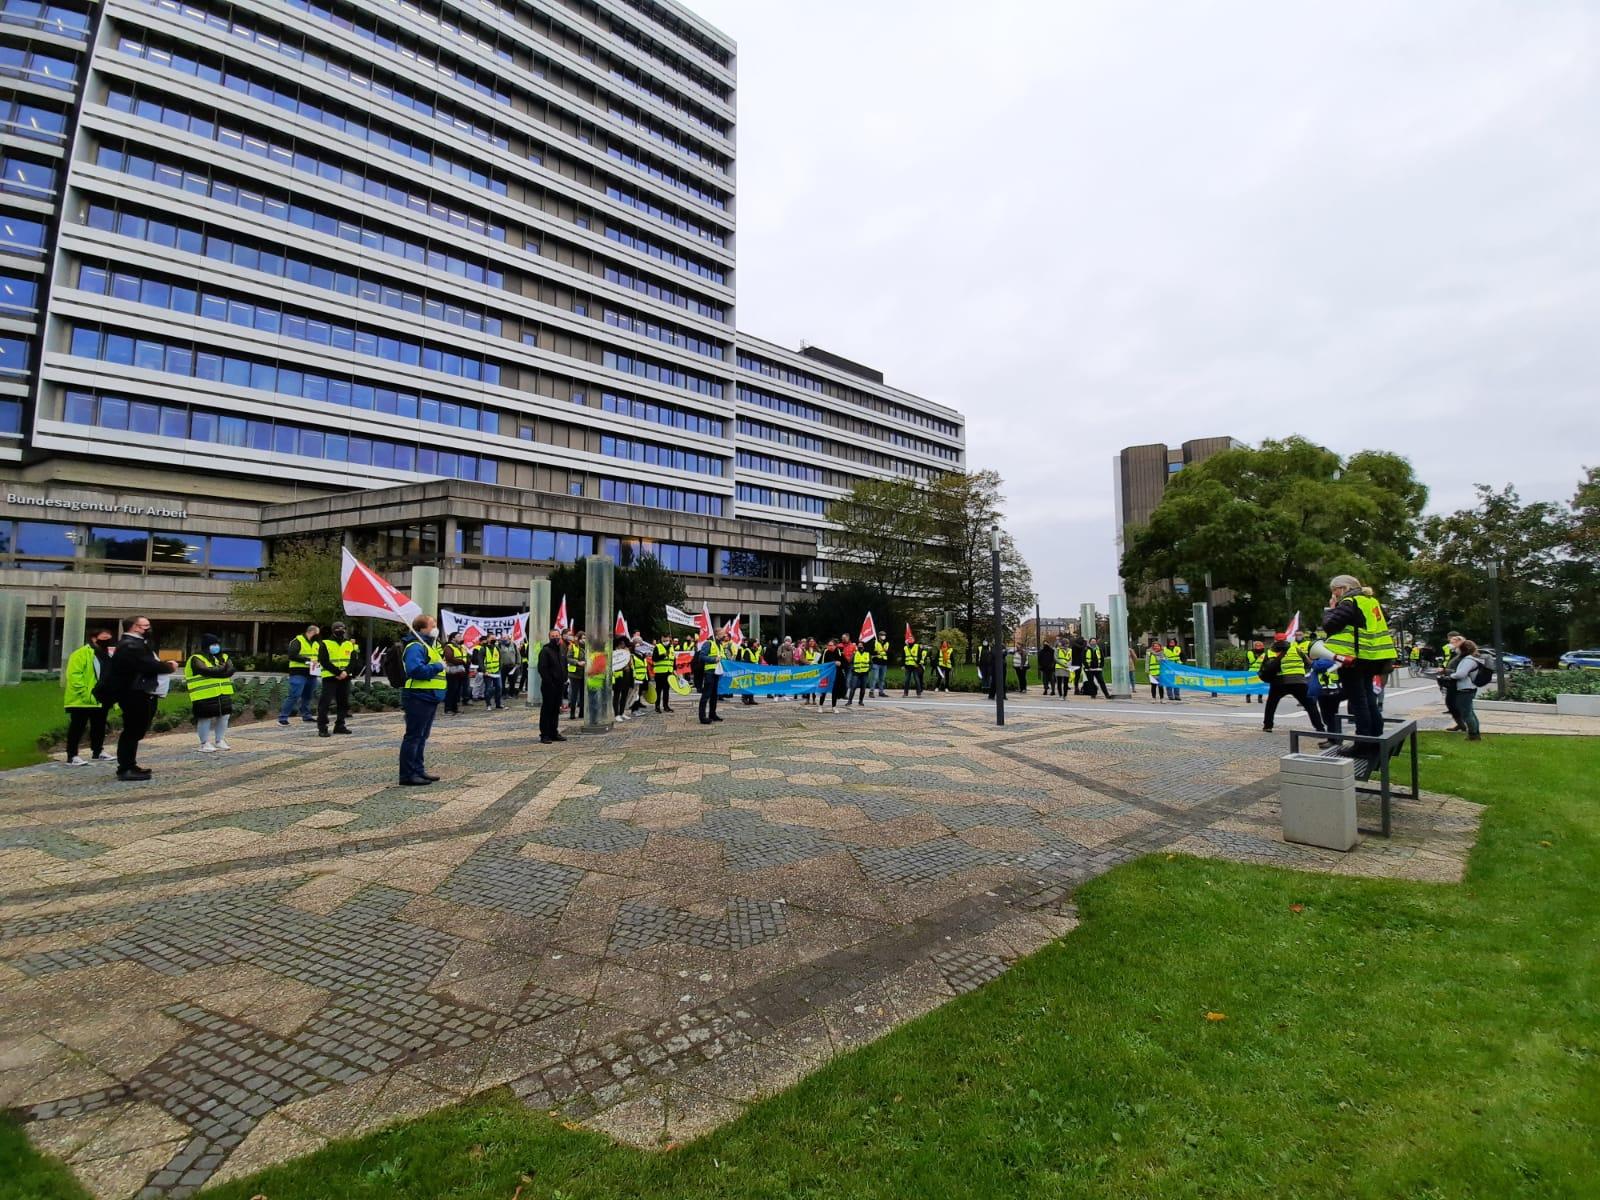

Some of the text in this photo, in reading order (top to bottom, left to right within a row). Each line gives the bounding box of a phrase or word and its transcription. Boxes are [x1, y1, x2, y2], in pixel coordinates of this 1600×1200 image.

[7, 493, 119, 513] Bundesagentur
[146, 506, 188, 519] Arbeit
[484, 618, 515, 627] SIND
